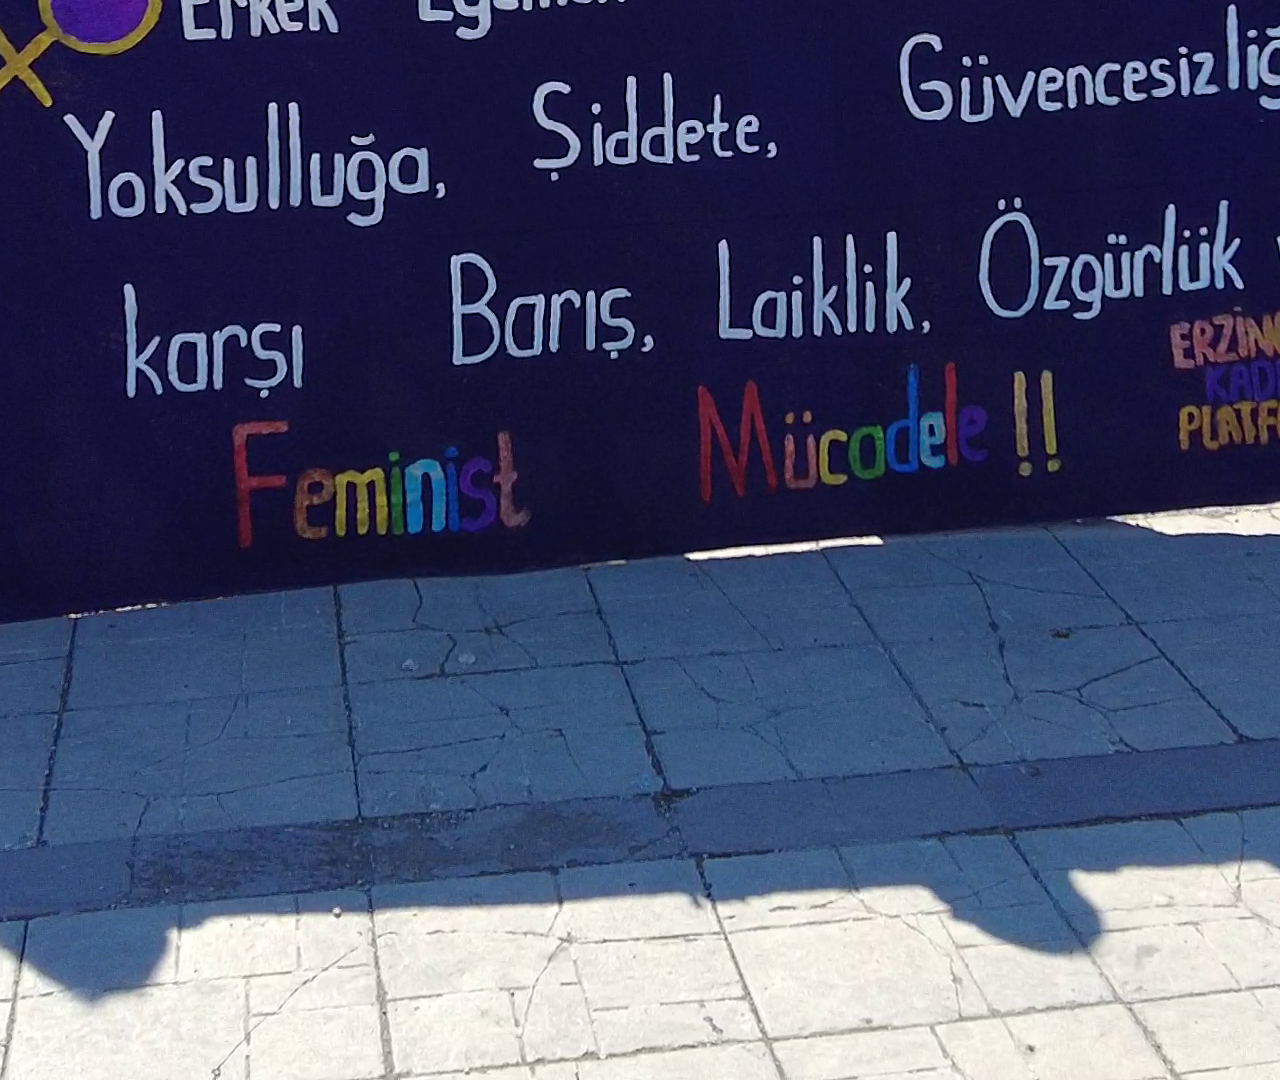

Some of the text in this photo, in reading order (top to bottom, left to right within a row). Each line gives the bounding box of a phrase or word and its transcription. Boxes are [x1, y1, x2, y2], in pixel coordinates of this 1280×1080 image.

[62, 101, 447, 228] Yoksulluğa,
[531, 72, 779, 182] Şiddete,
[122, 283, 304, 400] karşı
[449, 251, 656, 367] Barış,
[715, 230, 933, 340] Laiklik,
[977, 195, 1248, 322] Özgürlük
[231, 419, 532, 552] Feminist
[696, 361, 990, 504] Mücadele
